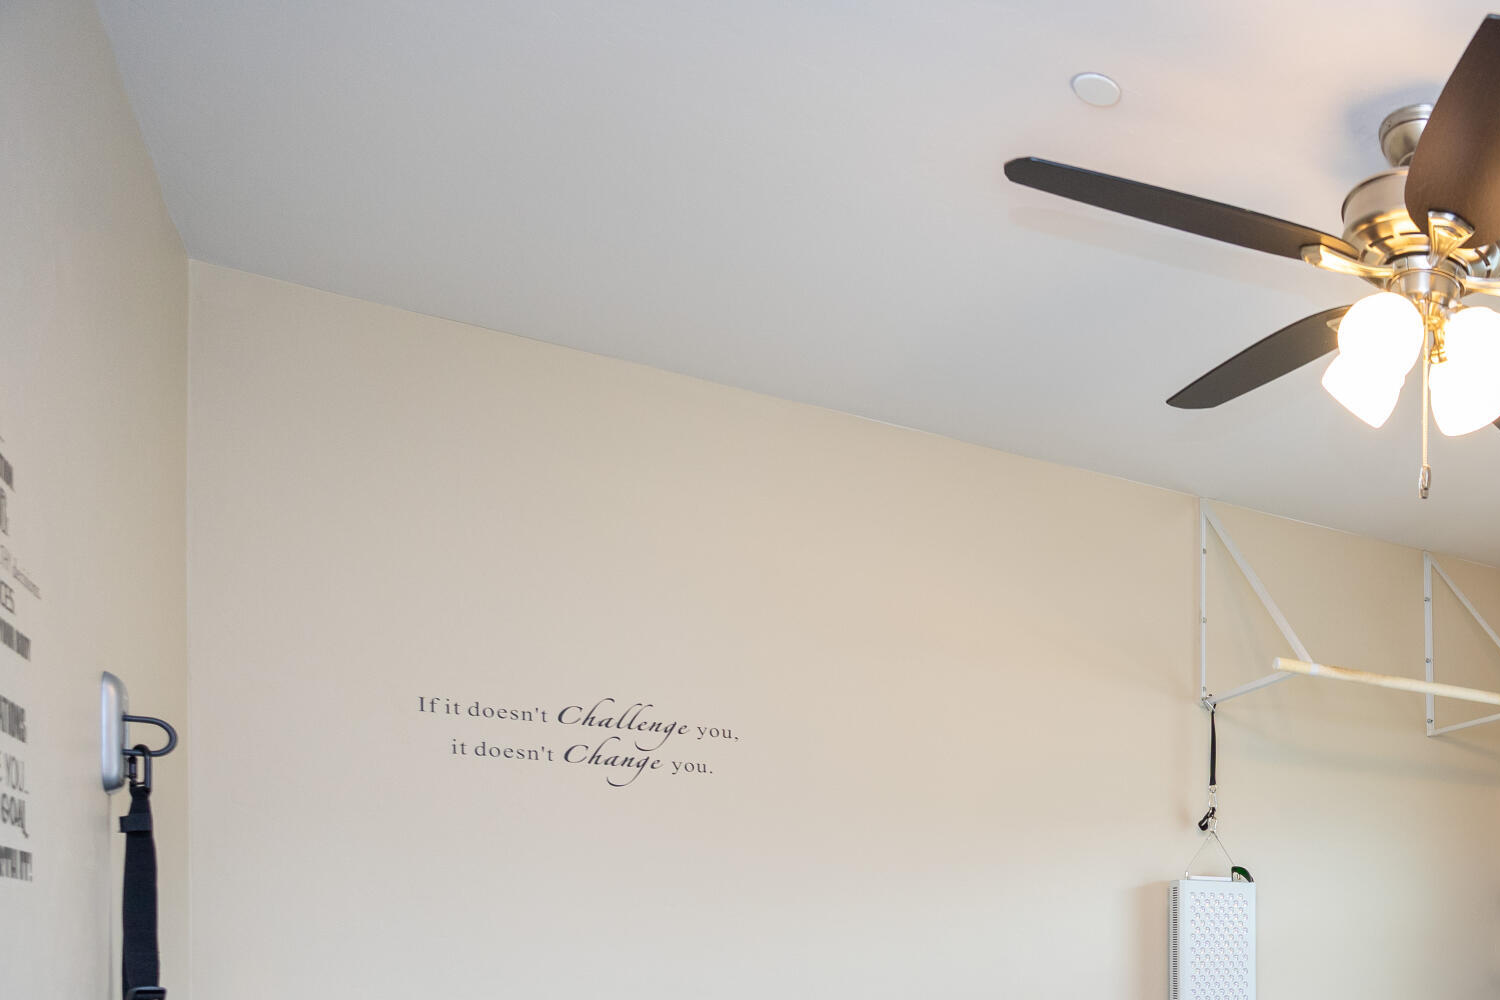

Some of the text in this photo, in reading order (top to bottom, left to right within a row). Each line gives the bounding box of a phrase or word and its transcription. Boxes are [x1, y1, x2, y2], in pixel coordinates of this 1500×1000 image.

[417, 696, 740, 752] If it doesn't Challenge you,
[451, 736, 714, 787] it doesn't Change you.
